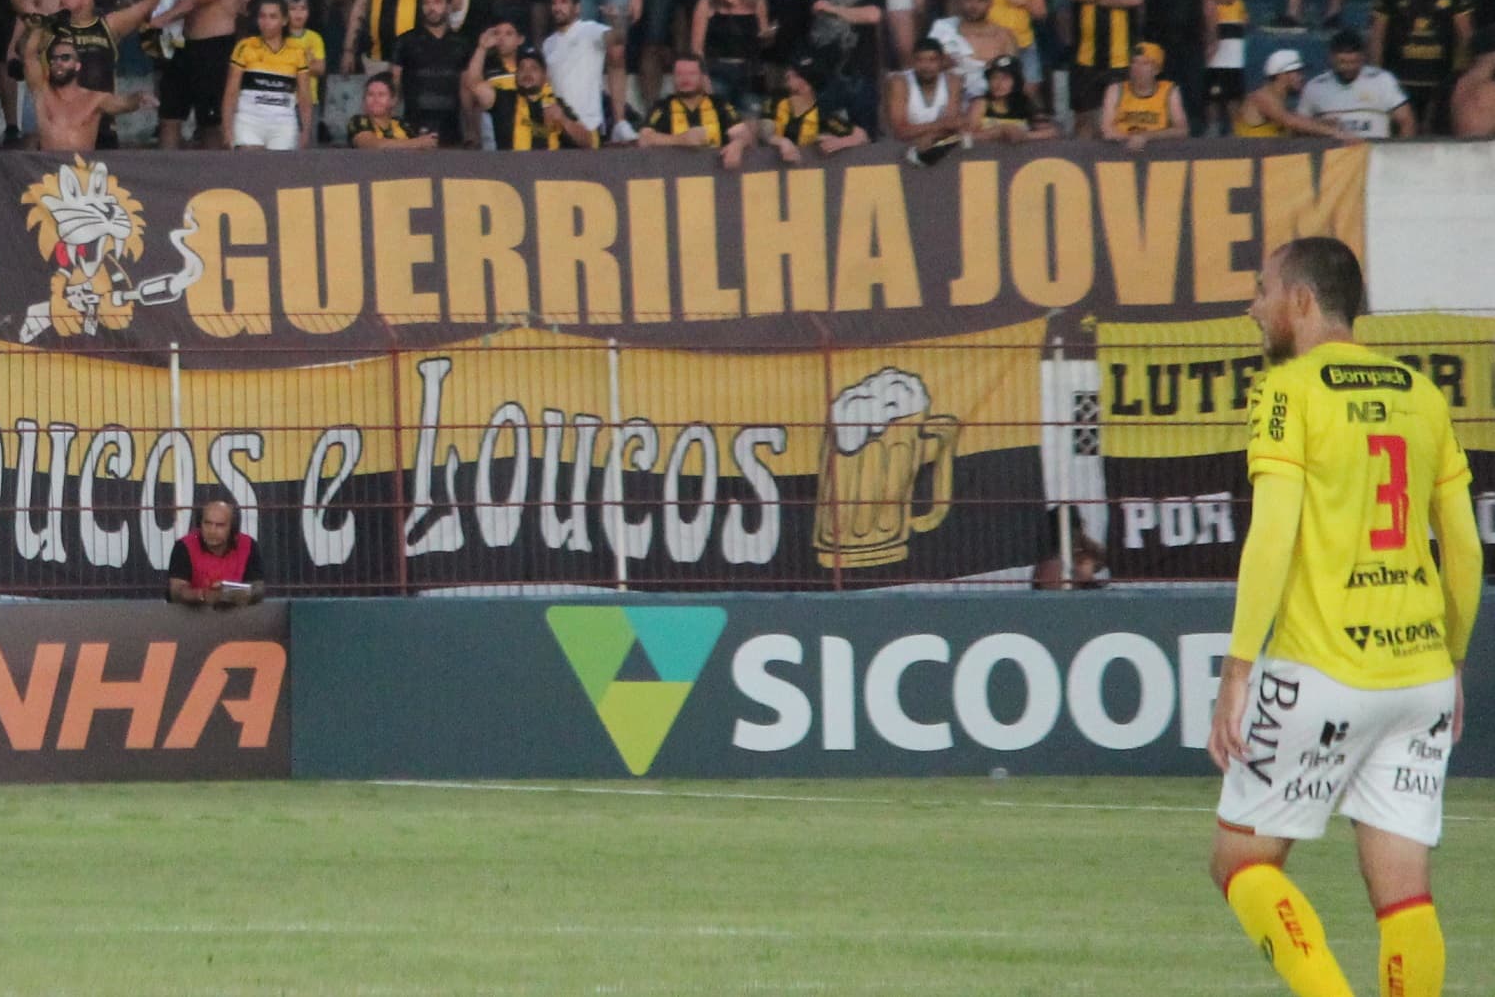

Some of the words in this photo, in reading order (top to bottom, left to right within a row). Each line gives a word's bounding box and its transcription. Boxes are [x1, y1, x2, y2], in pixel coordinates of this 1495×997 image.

[188, 163, 922, 339] GUERRILHA
[303, 423, 364, 567] e
[406, 357, 788, 566] Loucos
[1121, 491, 1236, 549] POR
[1366, 433, 1410, 552] 3
